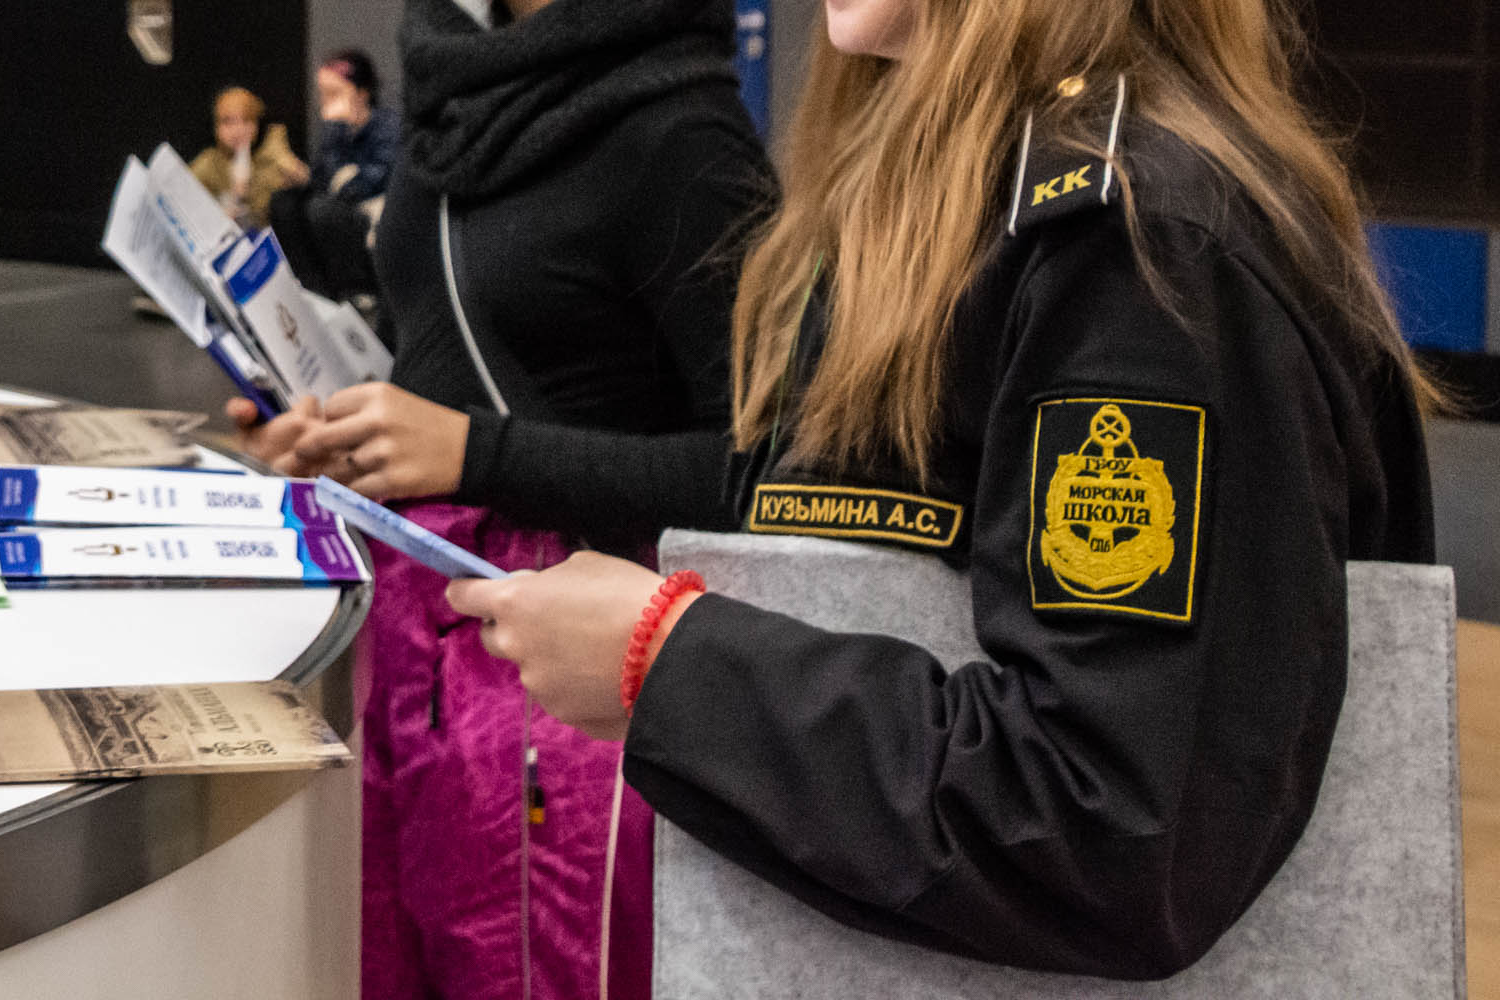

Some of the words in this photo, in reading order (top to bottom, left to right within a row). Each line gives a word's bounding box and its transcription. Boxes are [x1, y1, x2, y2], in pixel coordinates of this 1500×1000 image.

[1031, 164, 1092, 207] КК
[1069, 485, 1145, 502] МОРСКАЯ
[760, 495, 880, 525] КУЗЬМИНА
[886, 503, 941, 535] А.С.
